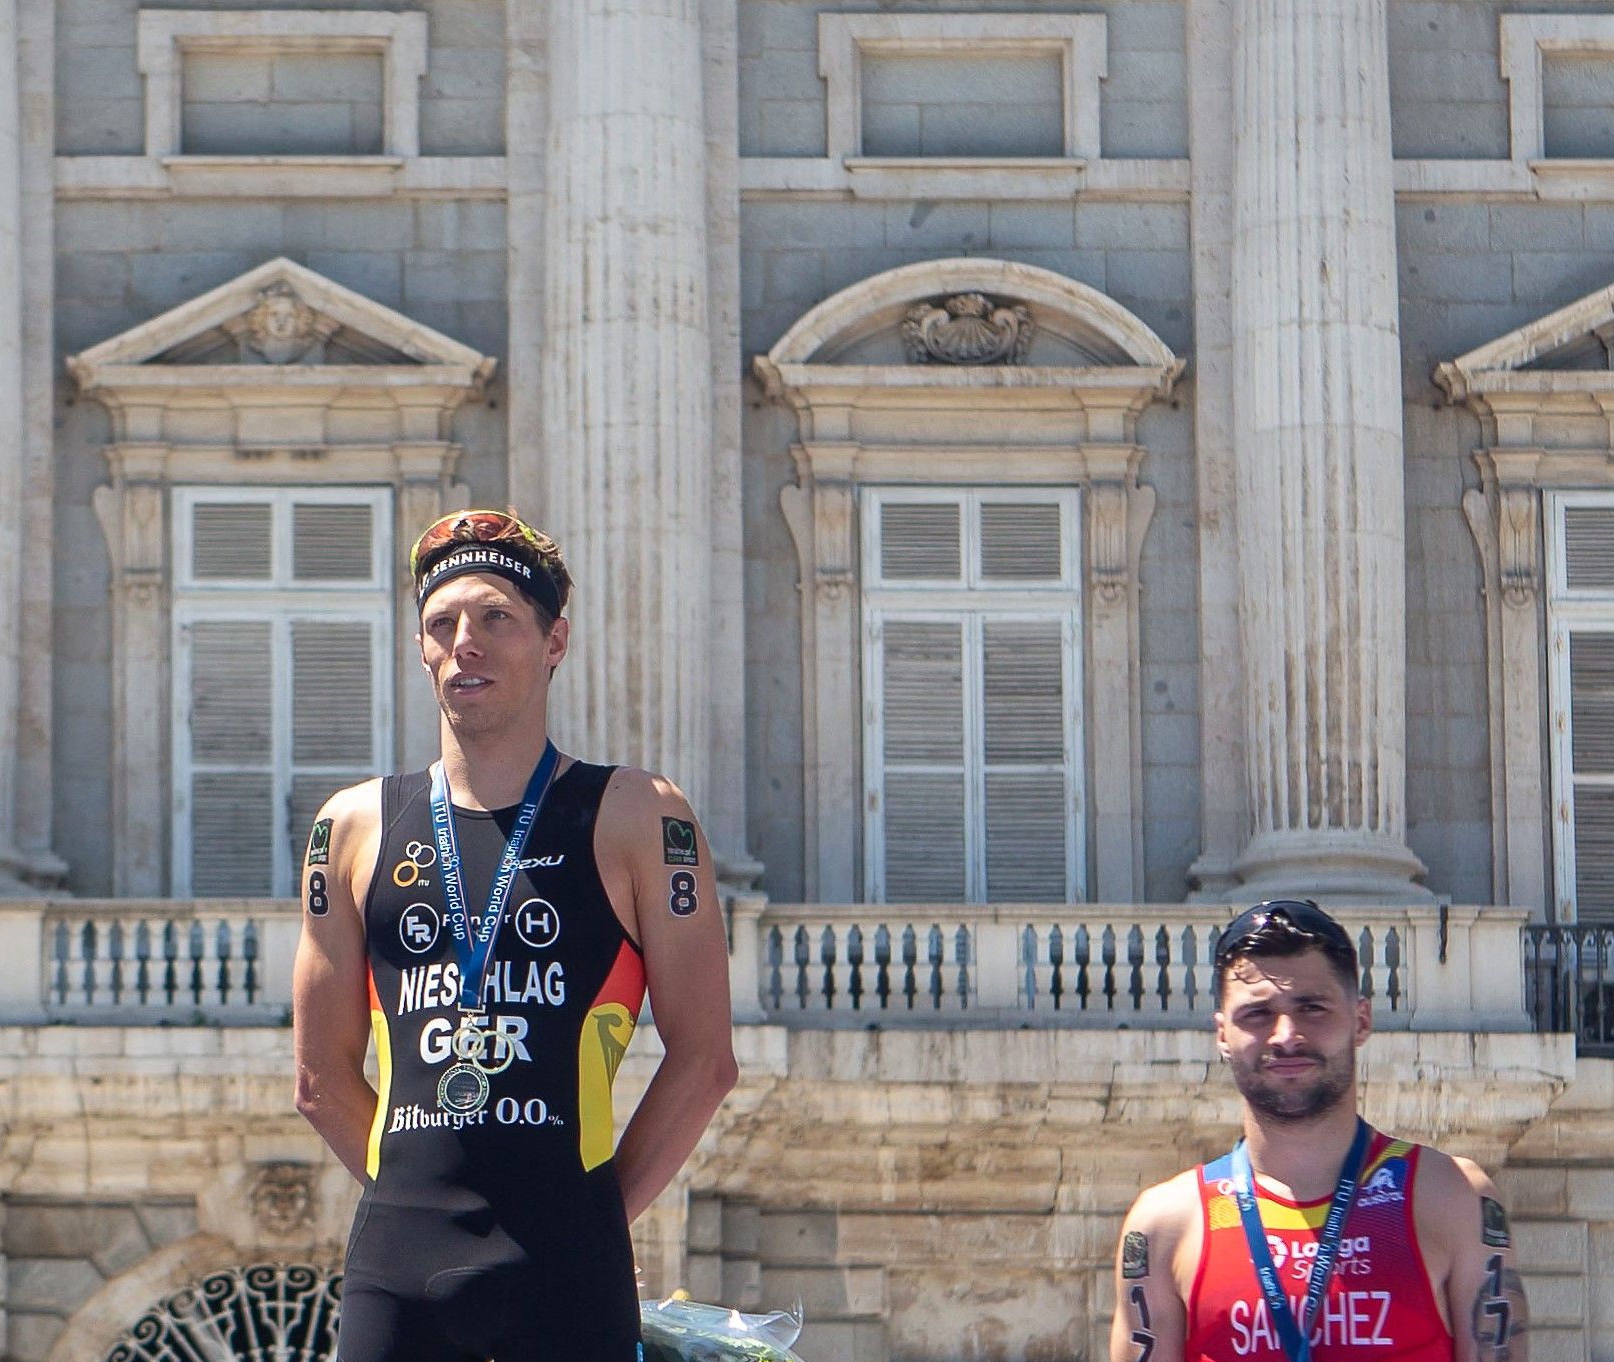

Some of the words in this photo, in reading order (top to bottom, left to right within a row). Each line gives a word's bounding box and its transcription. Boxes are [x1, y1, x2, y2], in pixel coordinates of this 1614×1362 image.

[432, 551, 532, 580] SENNHEISER
[518, 803, 537, 825] ITU
[433, 801, 448, 824] ITU
[443, 871, 461, 911] World
[452, 913, 466, 940] Cup
[308, 869, 330, 917] 8
[489, 873, 510, 913] World
[669, 869, 699, 918] 8
[478, 916, 497, 943] Cup
[397, 960, 566, 1016] NIESHLAG
